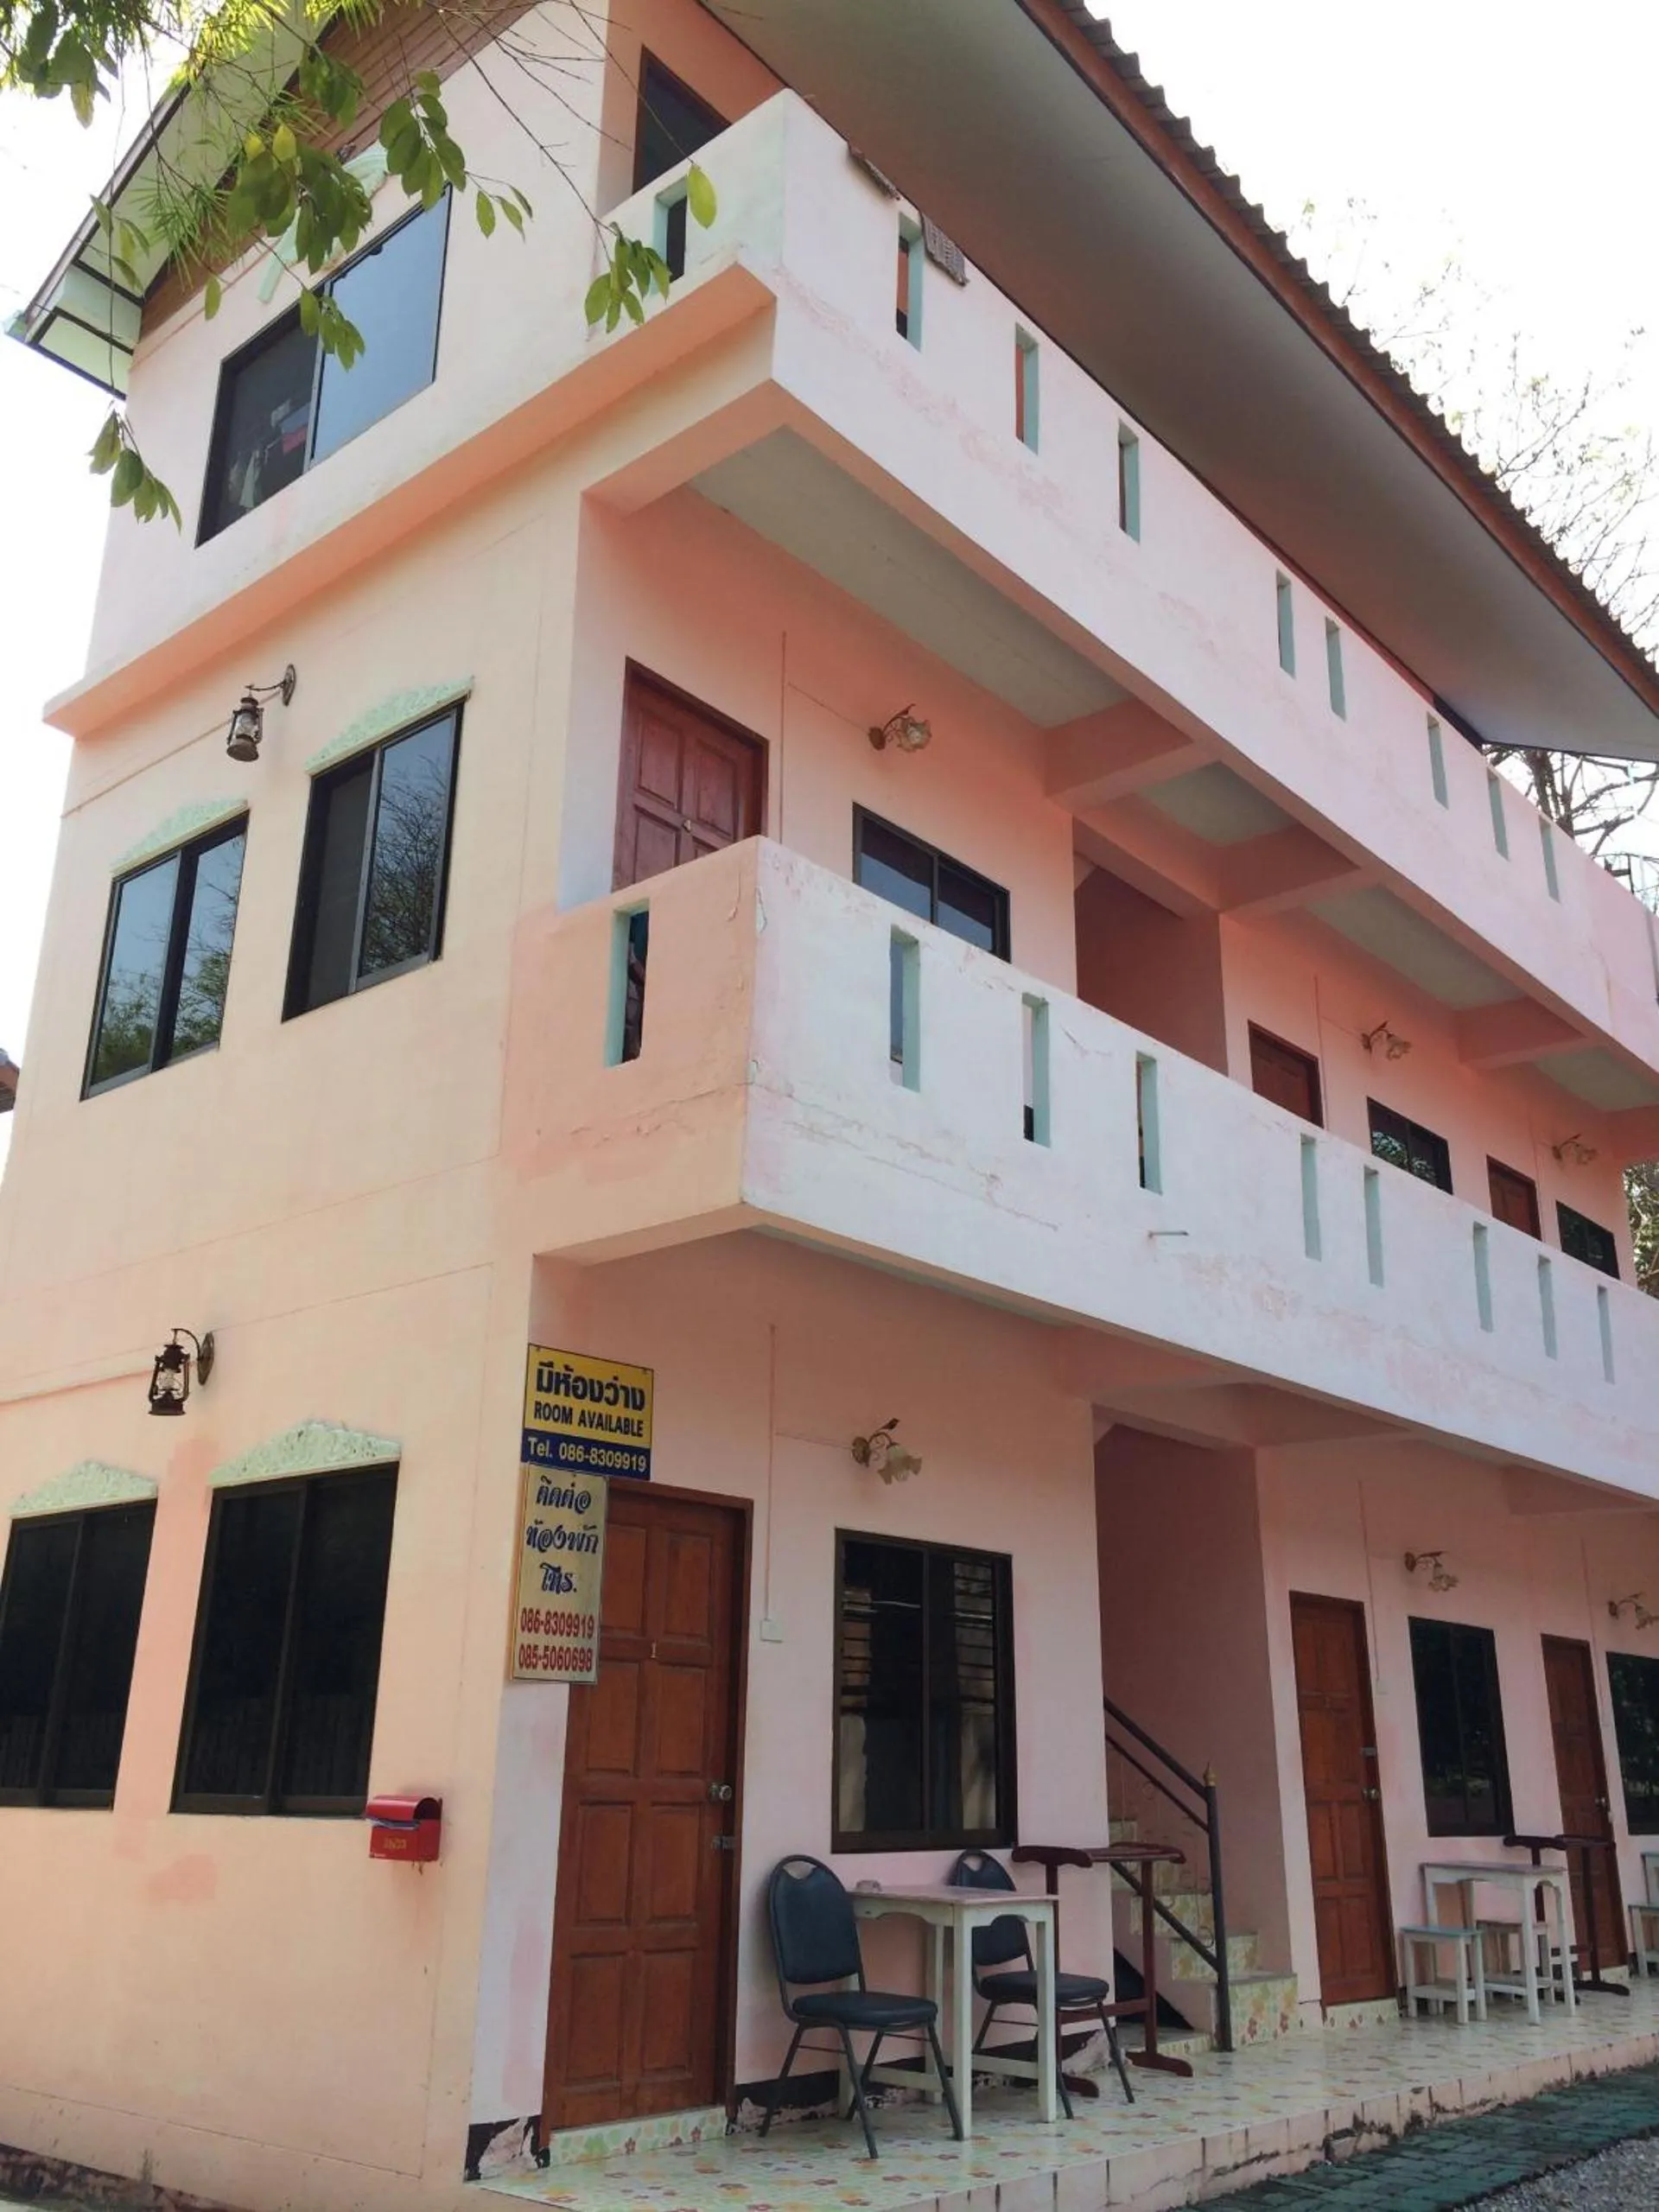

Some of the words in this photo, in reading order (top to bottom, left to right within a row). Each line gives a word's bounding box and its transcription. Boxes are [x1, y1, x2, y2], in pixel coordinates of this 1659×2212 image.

[534, 1400, 573, 1425] ROOM
[577, 1409, 644, 1438] AVAILABLE
[528, 1436, 553, 1459] Tel.
[559, 1442, 647, 1472] 086-8309919
[536, 1475, 592, 1514] ติดต่อ
[526, 1519, 599, 1554] ห้องพัก
[539, 1561, 577, 1594] โทร.
[520, 1607, 594, 1640] 086-8309919
[518, 1644, 594, 1673] 085-5060698
